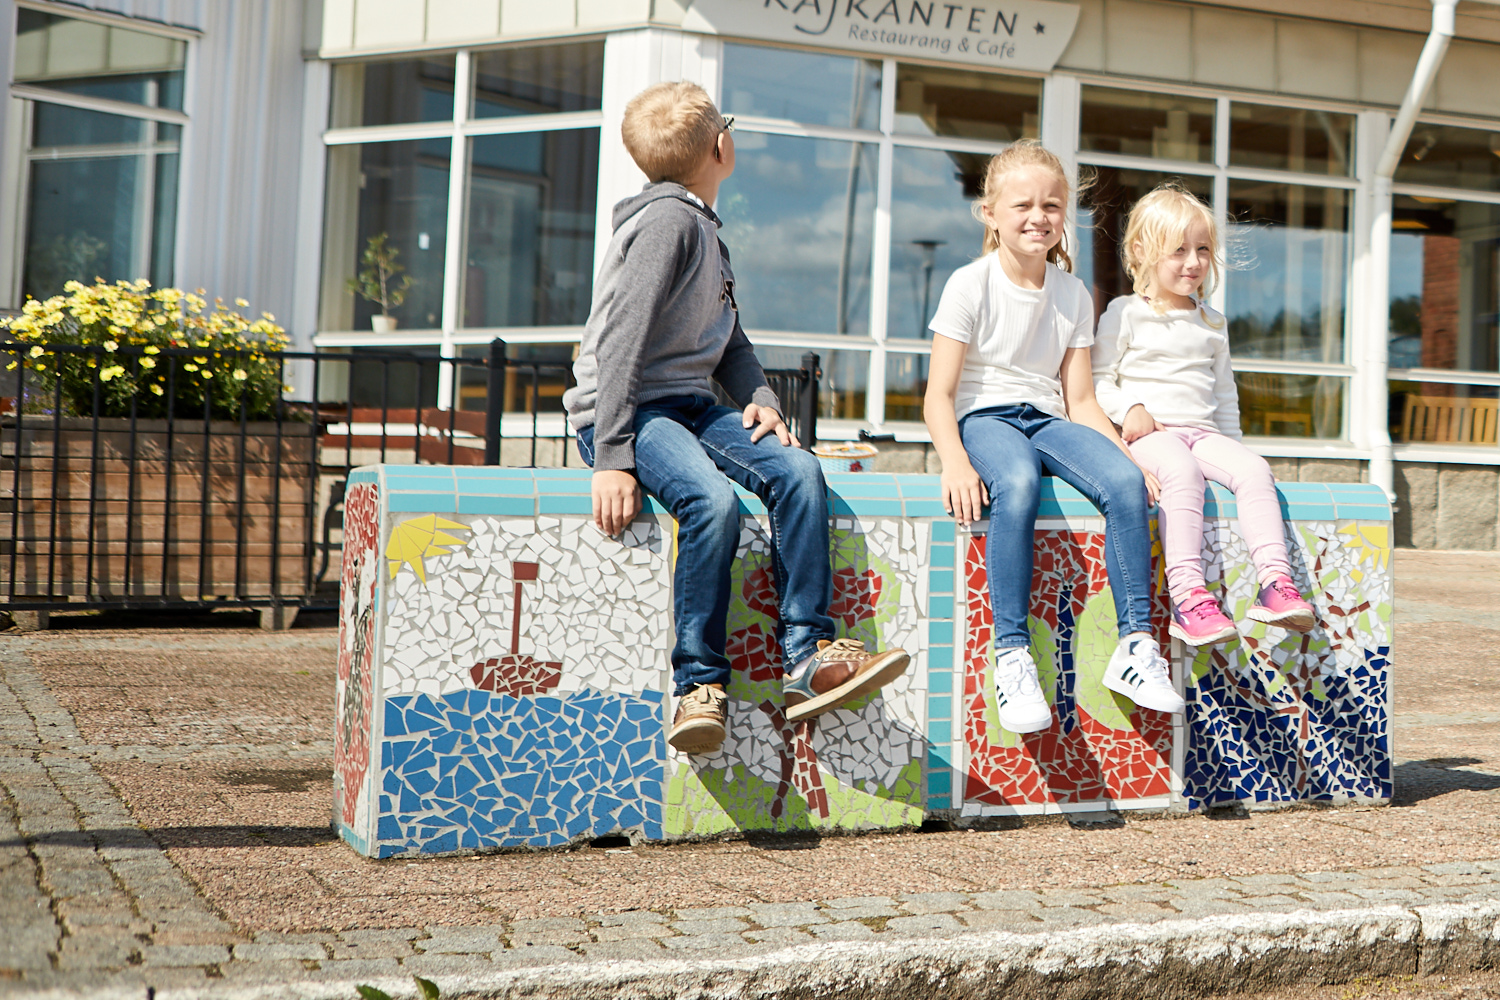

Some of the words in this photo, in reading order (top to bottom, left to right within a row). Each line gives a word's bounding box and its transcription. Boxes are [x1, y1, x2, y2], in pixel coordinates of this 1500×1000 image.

[848, 23, 952, 54] Restaurang
[957, 37, 970, 53] &
[976, 39, 1016, 60] Café
